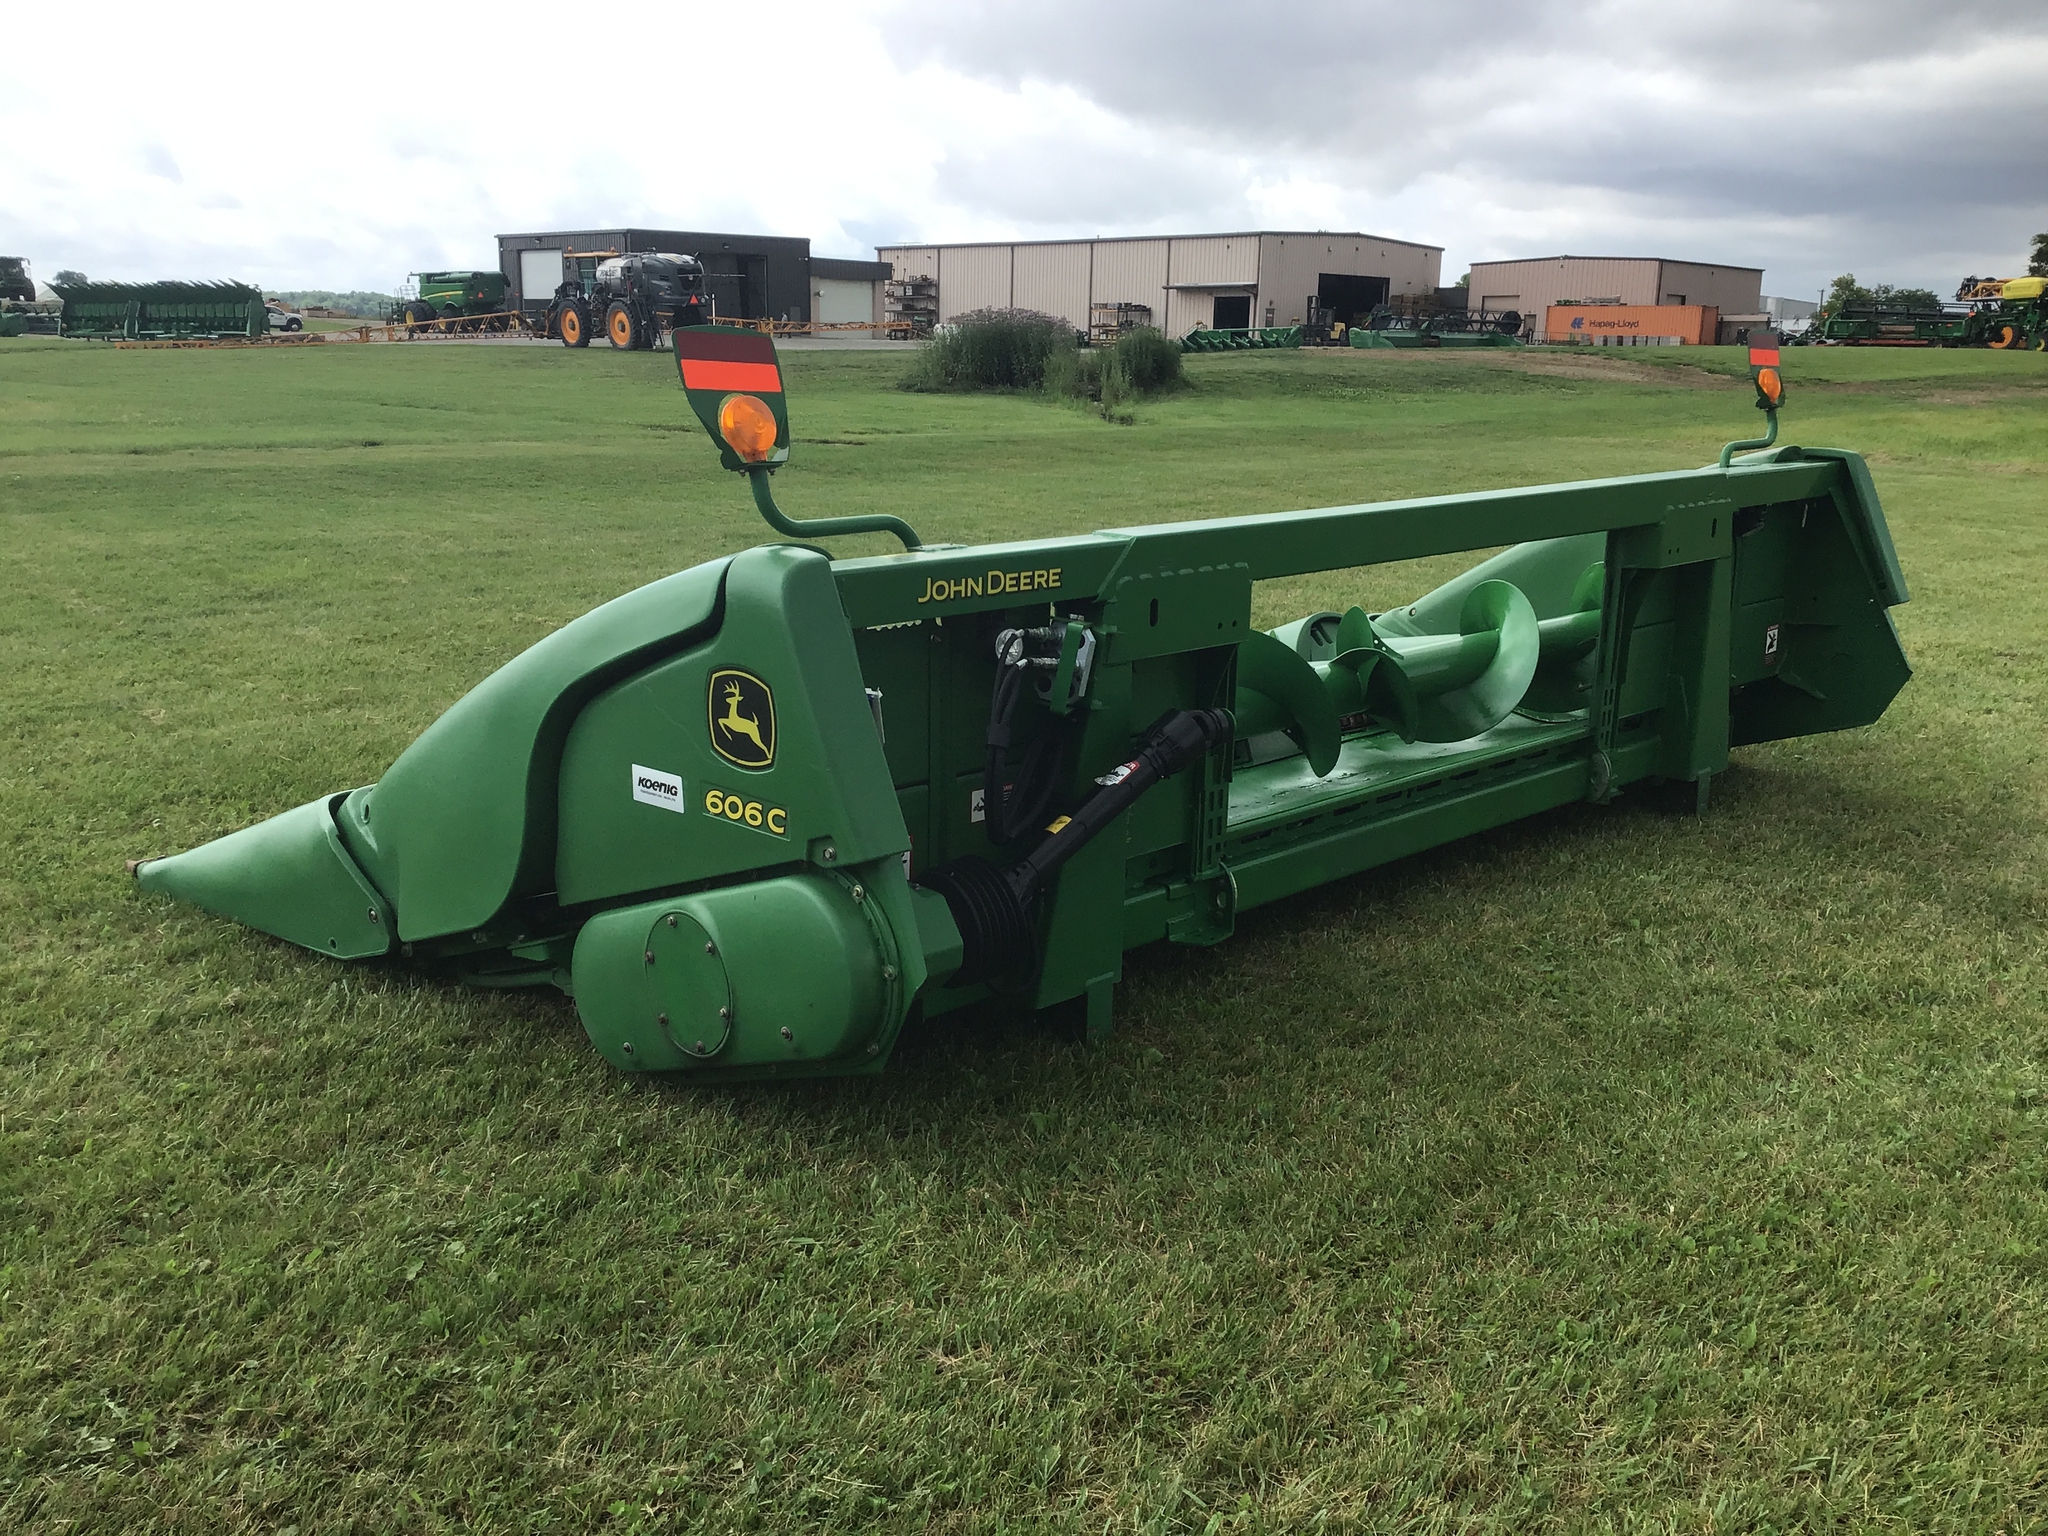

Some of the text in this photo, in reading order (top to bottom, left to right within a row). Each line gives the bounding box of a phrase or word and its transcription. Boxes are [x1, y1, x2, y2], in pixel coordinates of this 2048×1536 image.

[1589, 319, 1639, 329] Hapag-Lloyd
[917, 567, 1062, 603] JOHN DEERE
